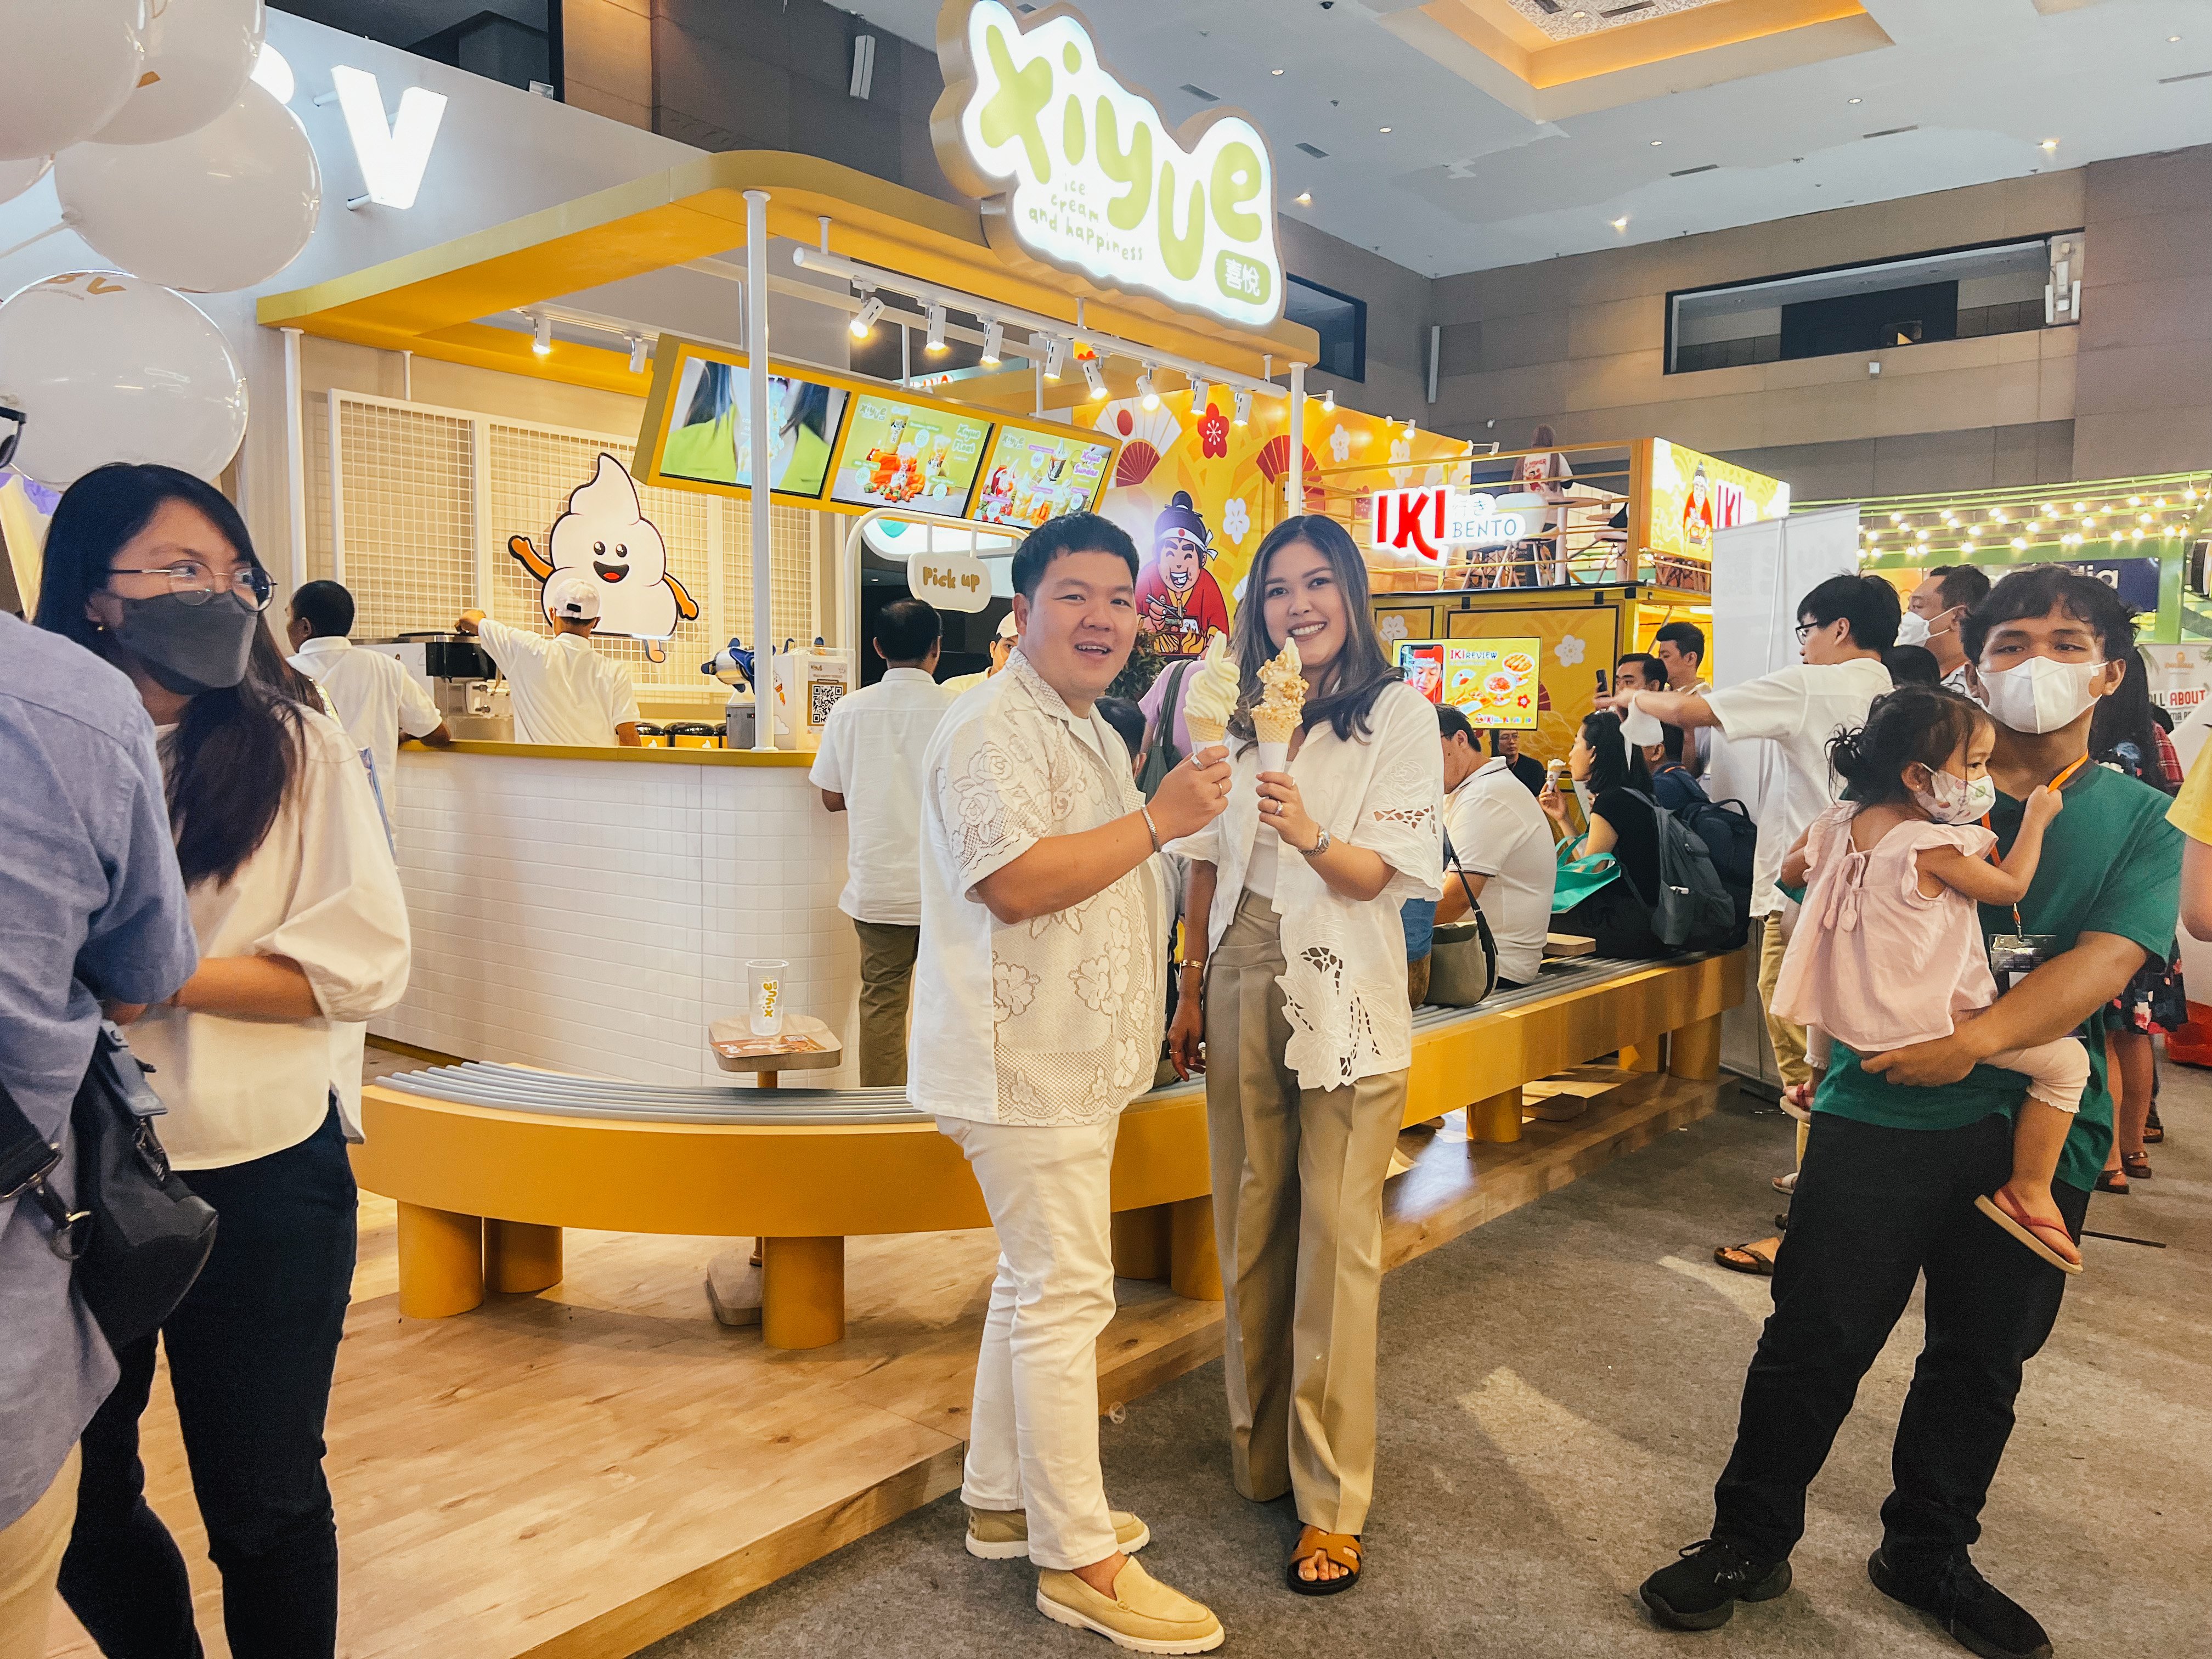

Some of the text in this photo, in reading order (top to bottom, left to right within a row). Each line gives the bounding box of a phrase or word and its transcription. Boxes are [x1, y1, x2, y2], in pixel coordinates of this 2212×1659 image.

[1064, 173, 1086, 196] ice
[1051, 194, 1099, 223] cream
[1029, 207, 1143, 261] and happiness
[1377, 489, 1446, 561] IKI
[1453, 518, 1517, 538] BENTO
[923, 566, 980, 593] Pick up
[1450, 650, 1465, 659] IKI
[2170, 690, 2205, 706] ABOUT
[763, 982, 777, 1018] xiyue
